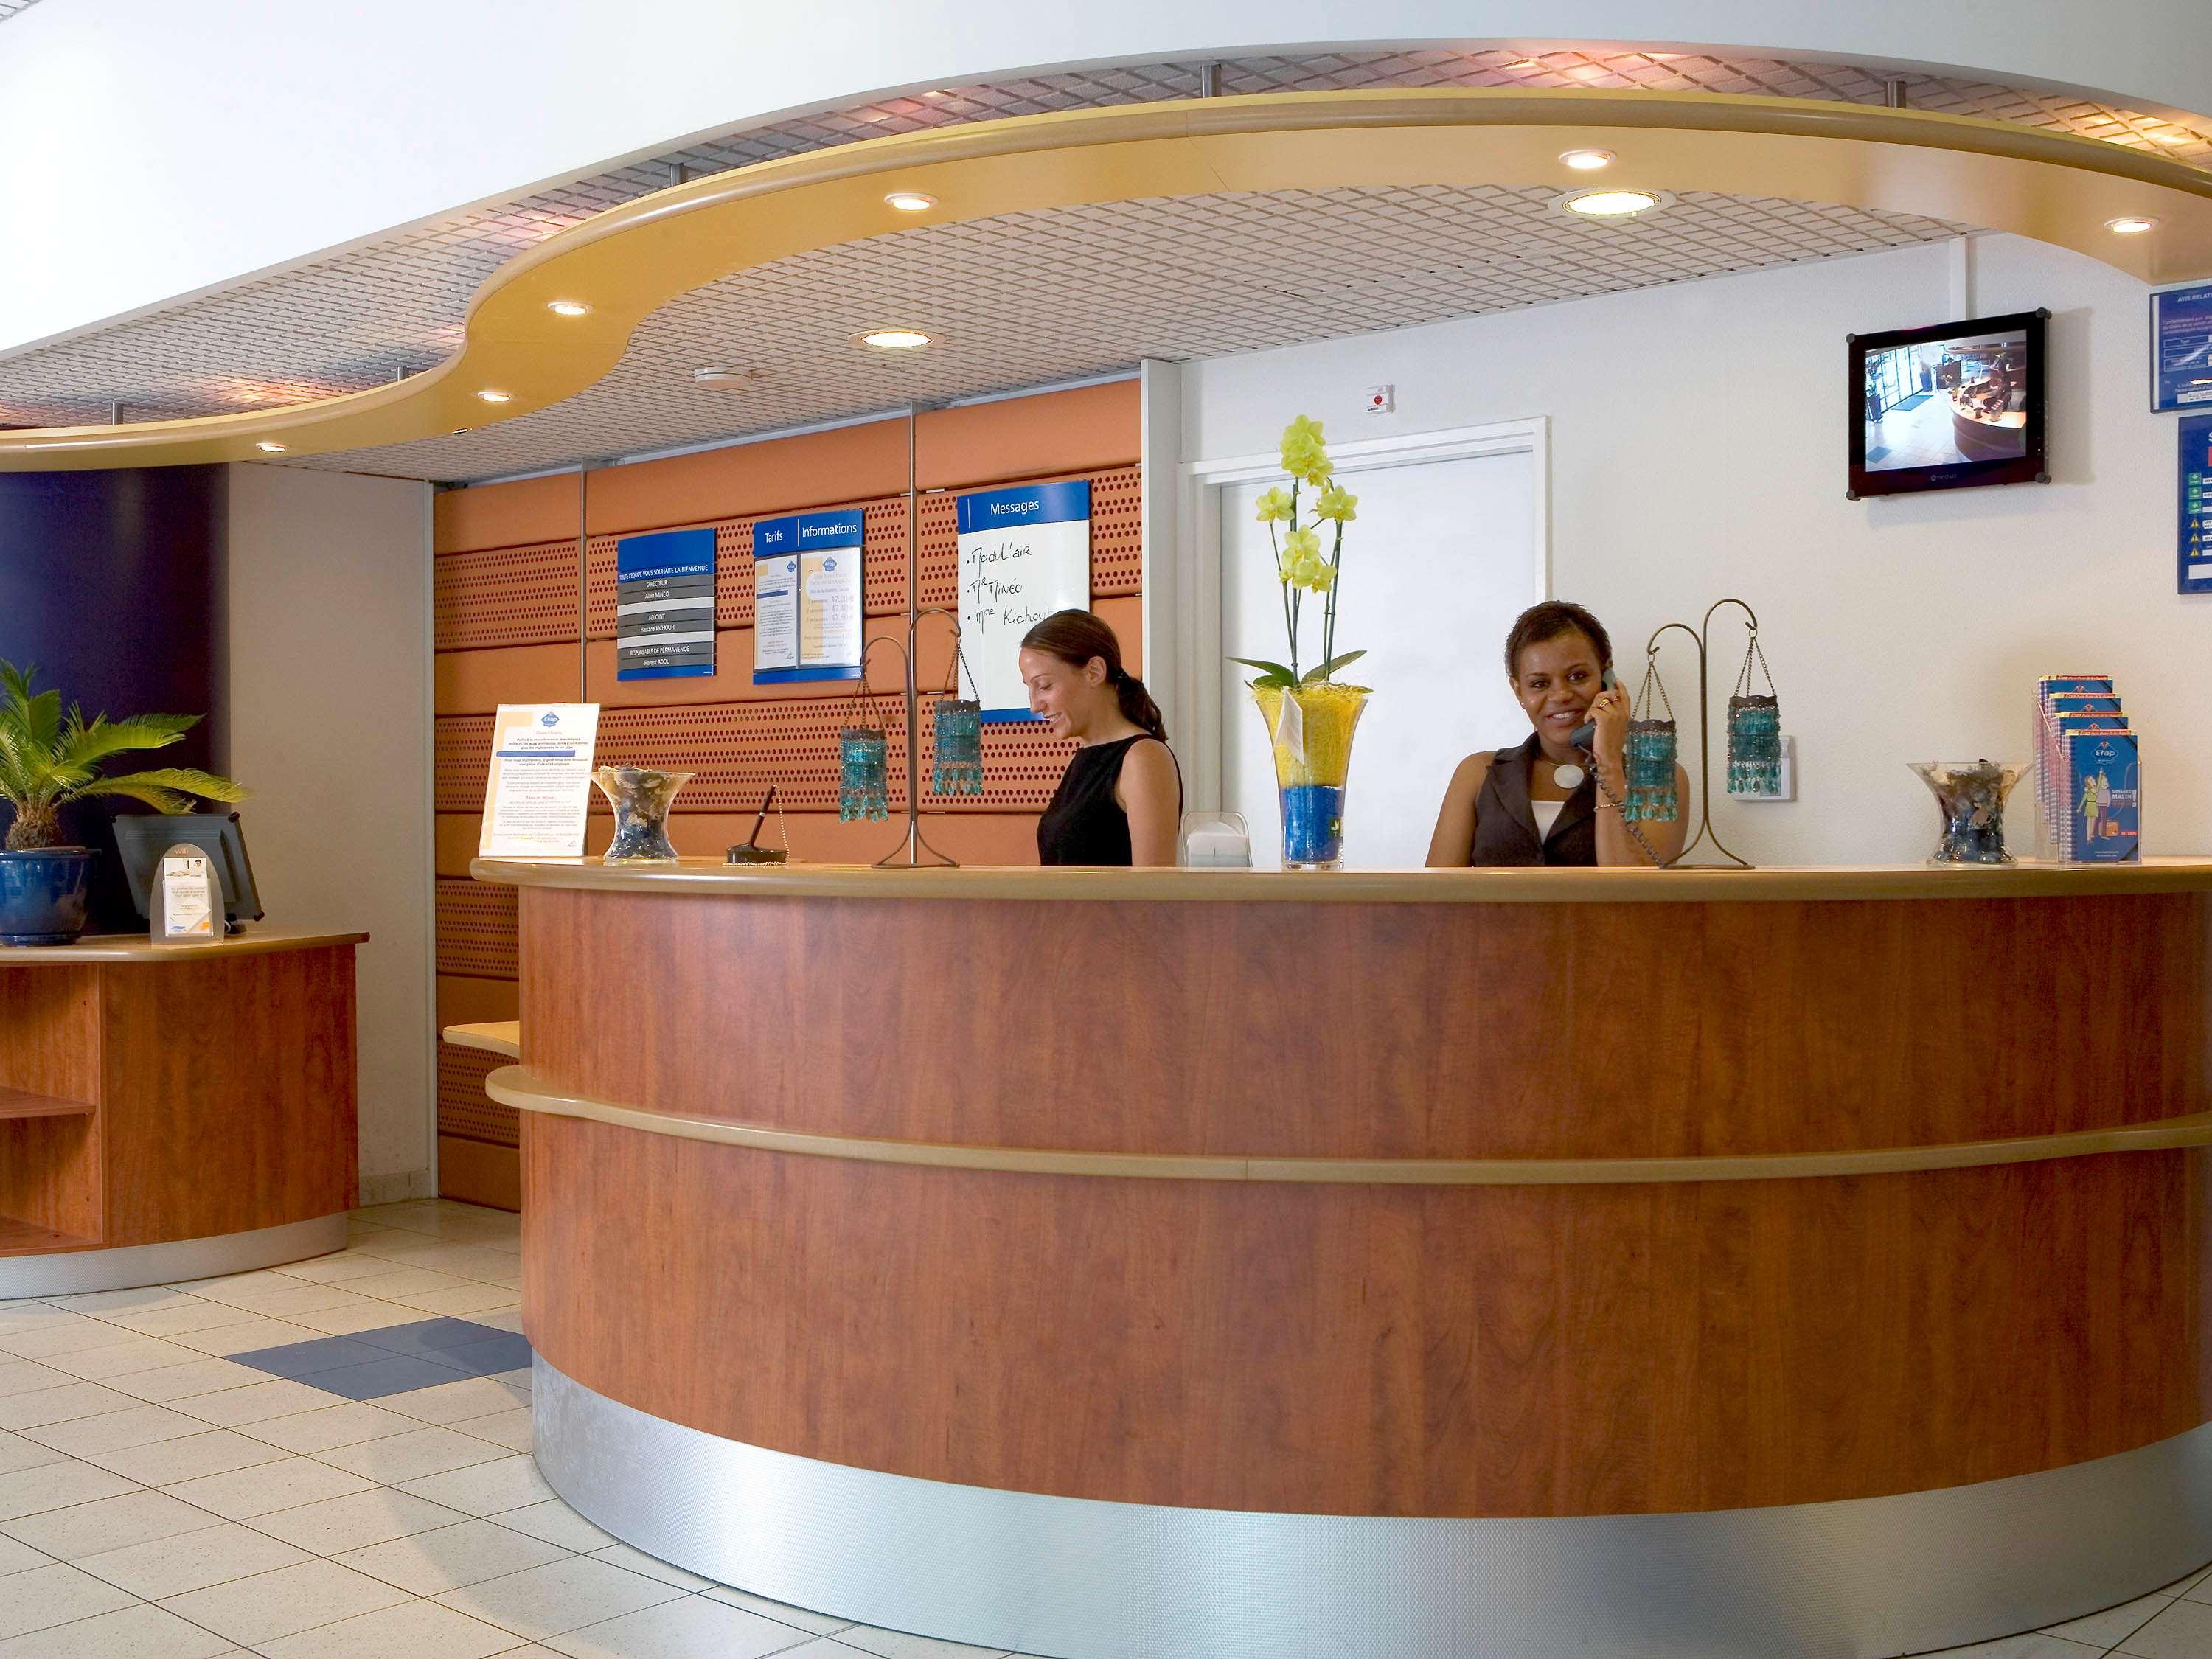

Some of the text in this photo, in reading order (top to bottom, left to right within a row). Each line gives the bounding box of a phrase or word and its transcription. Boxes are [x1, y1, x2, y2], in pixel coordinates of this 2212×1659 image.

[990, 501, 1040, 515] Messages
[765, 523, 857, 543] Tarifs Informations
[653, 567, 674, 575] SOUHAITE
[681, 564, 709, 572] BIENVENUE
[646, 580, 668, 588] DIRECTEUR
[660, 646, 689, 654] PERMANENCE
[2095, 749, 2115, 757] Etap
